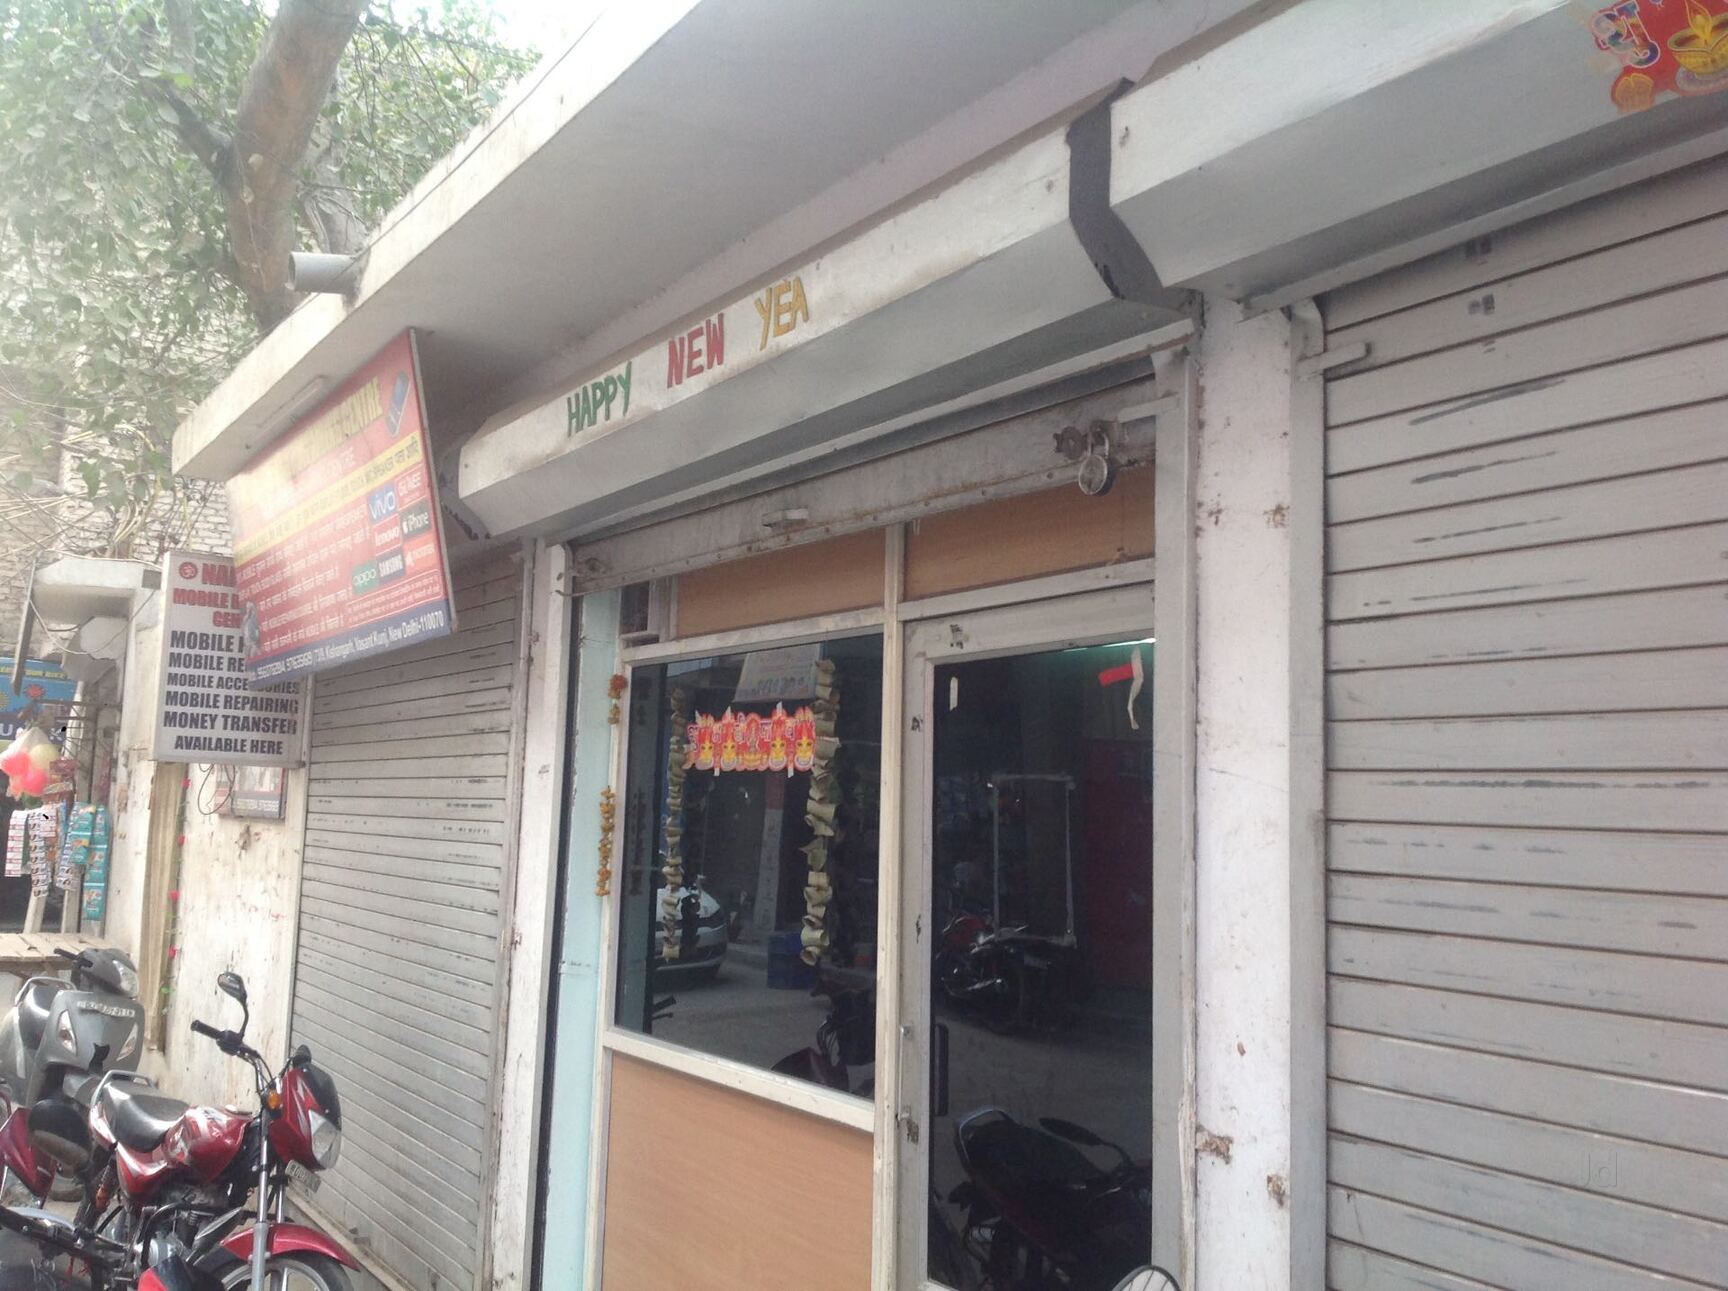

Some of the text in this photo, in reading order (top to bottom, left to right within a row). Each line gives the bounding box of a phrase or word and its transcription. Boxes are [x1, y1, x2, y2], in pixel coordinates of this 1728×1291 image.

[567, 276, 809, 438] HAPPY NEW YEA
[369, 490, 396, 520] vivo
[407, 511, 430, 532] iPhone
[353, 568, 377, 586] oppo
[173, 587, 229, 609] MOBILE
[170, 630, 234, 652] MOBILE
[168, 652, 224, 672] MOBILE
[166, 672, 214, 690] MOBILE
[165, 691, 299, 714] MOBILE REPAIRING
[163, 711, 297, 735] MONEY TRANSFER
[174, 735, 283, 755] AVAILABLE HERE
